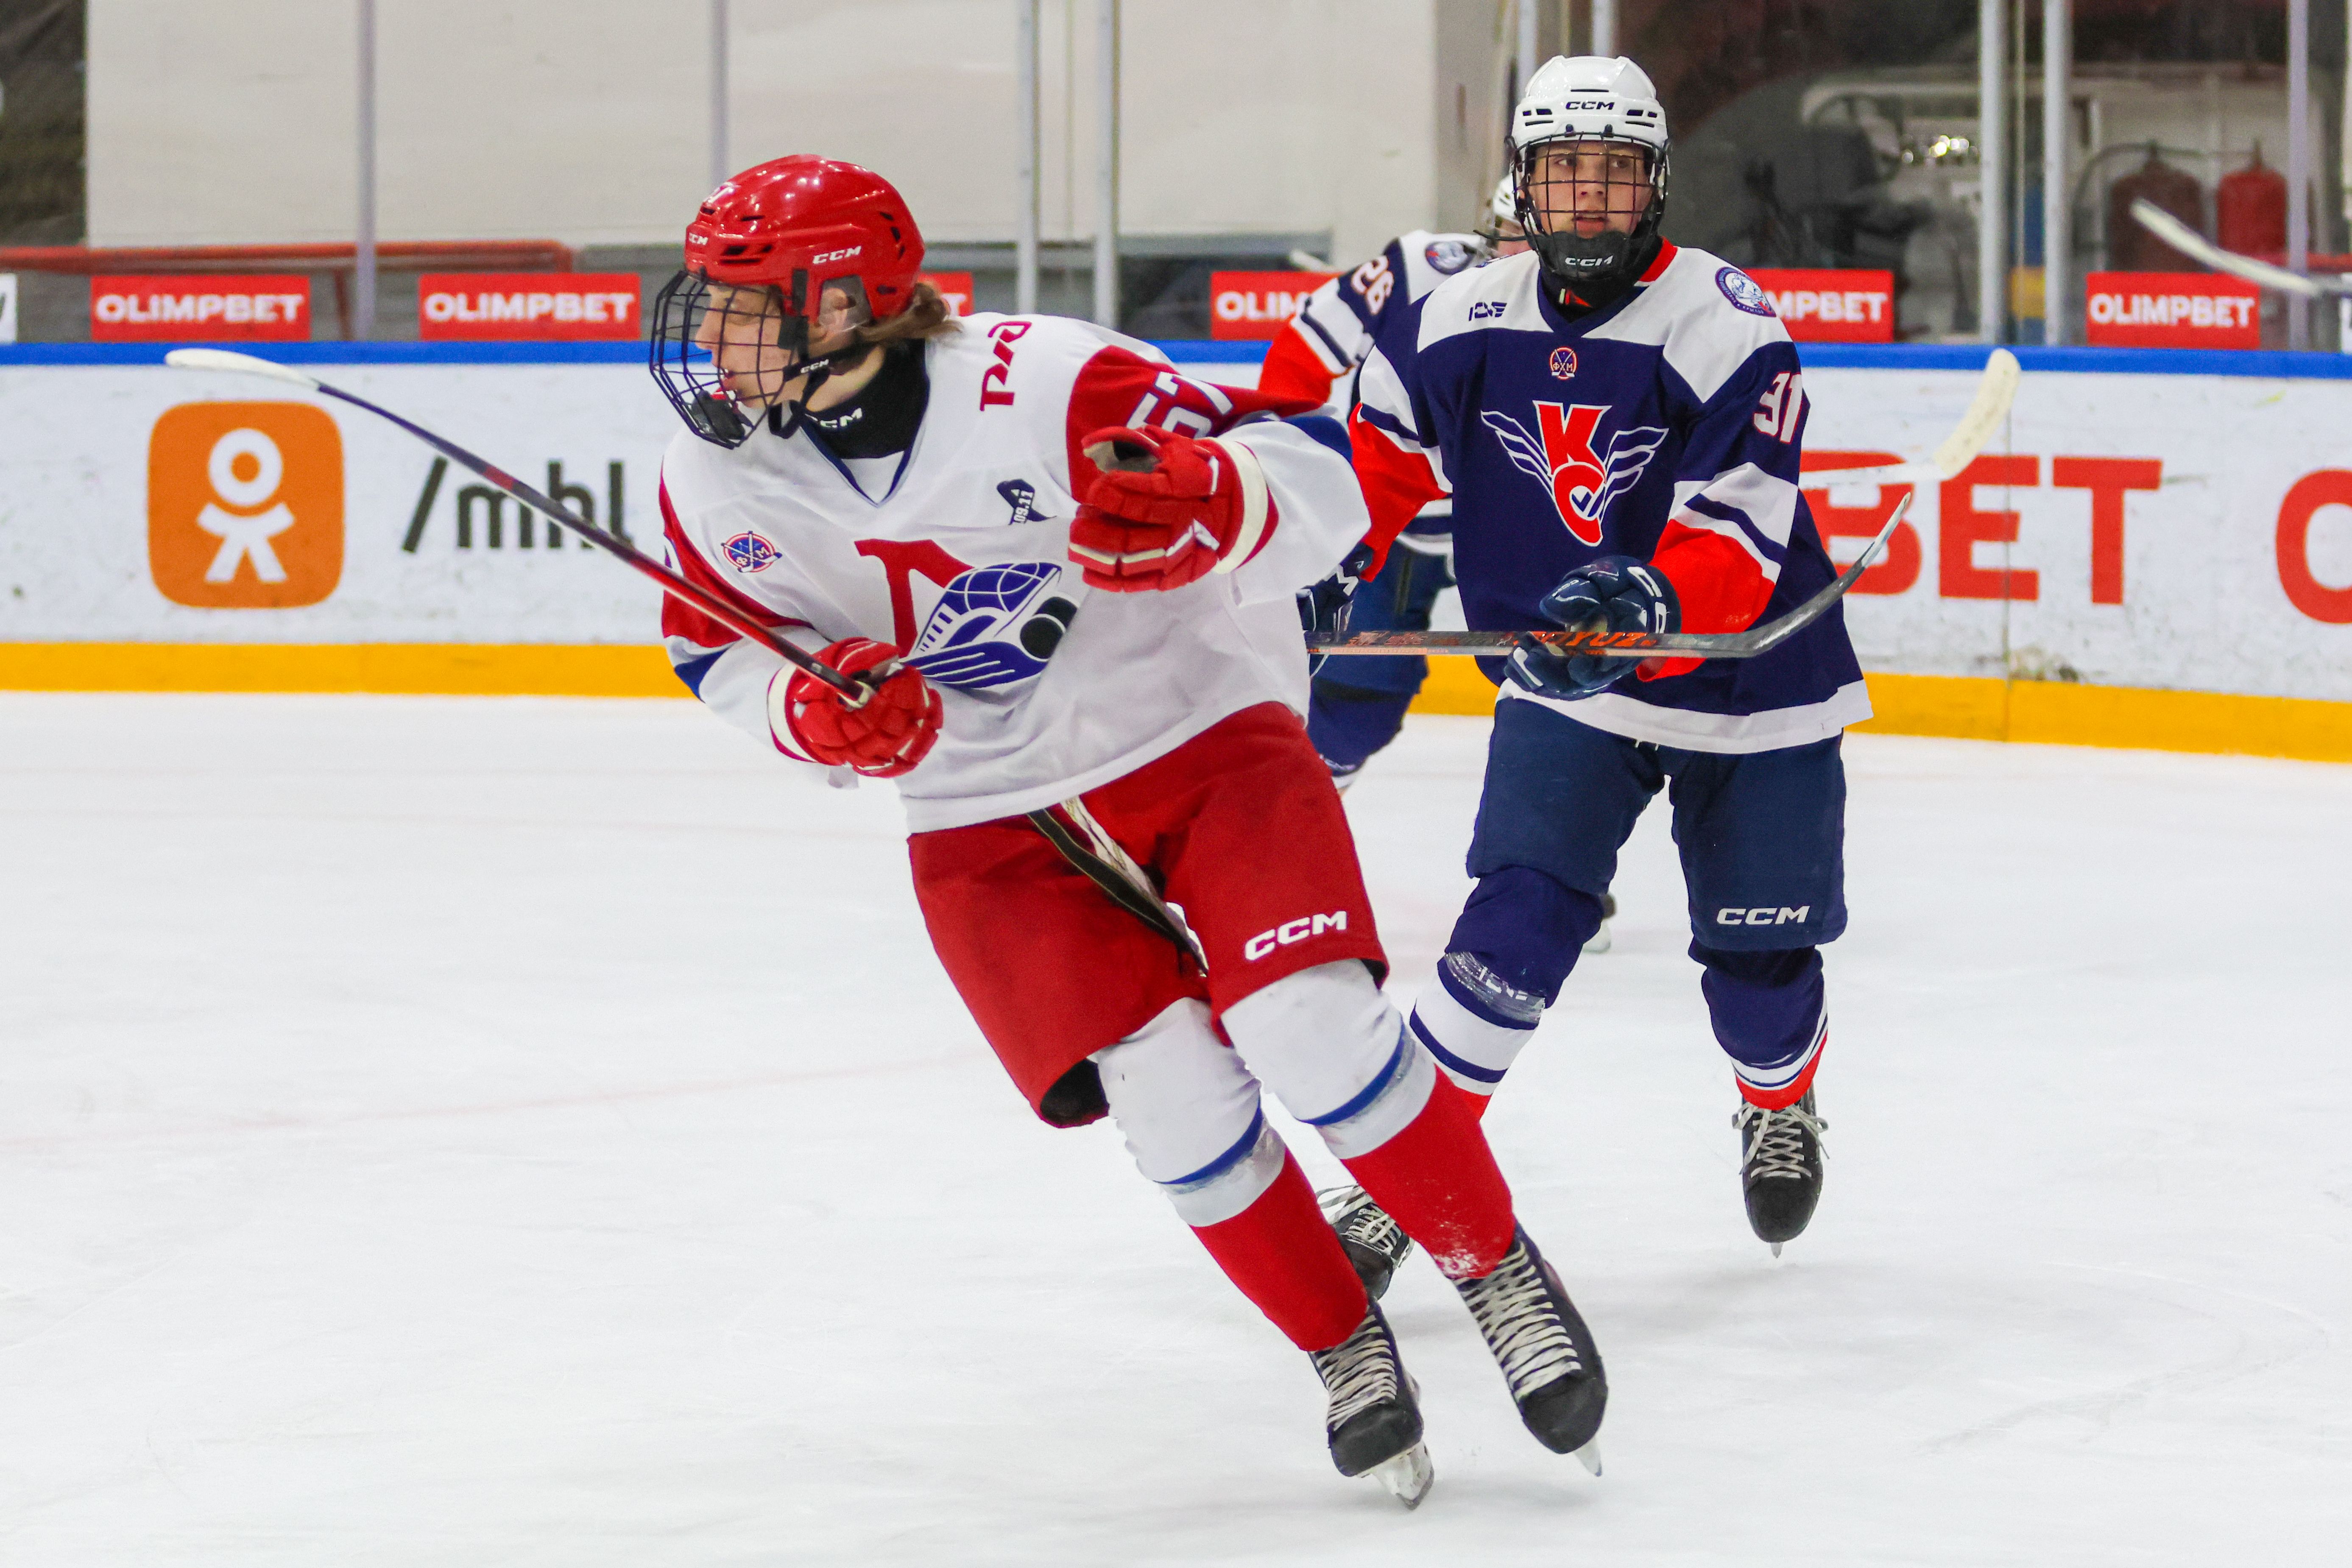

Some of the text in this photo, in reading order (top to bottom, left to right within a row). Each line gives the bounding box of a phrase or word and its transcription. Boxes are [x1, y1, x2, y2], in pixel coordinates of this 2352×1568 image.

[1565, 101, 1615, 110] CCM
[812, 245, 862, 264] CCM
[1350, 255, 1394, 315] 26
[95, 293, 304, 323] OLIMPBET
[424, 293, 634, 322] OLIMPBET
[1216, 292, 1311, 320] OLIM
[1764, 290, 1887, 322] MPBET
[2089, 293, 2255, 327] OLIMPBET
[800, 359, 830, 374] CCM
[805, 407, 863, 428] CM
[1753, 371, 1803, 444] 91
[1716, 905, 1810, 926] CCM
[1244, 910, 1348, 961] CCM
